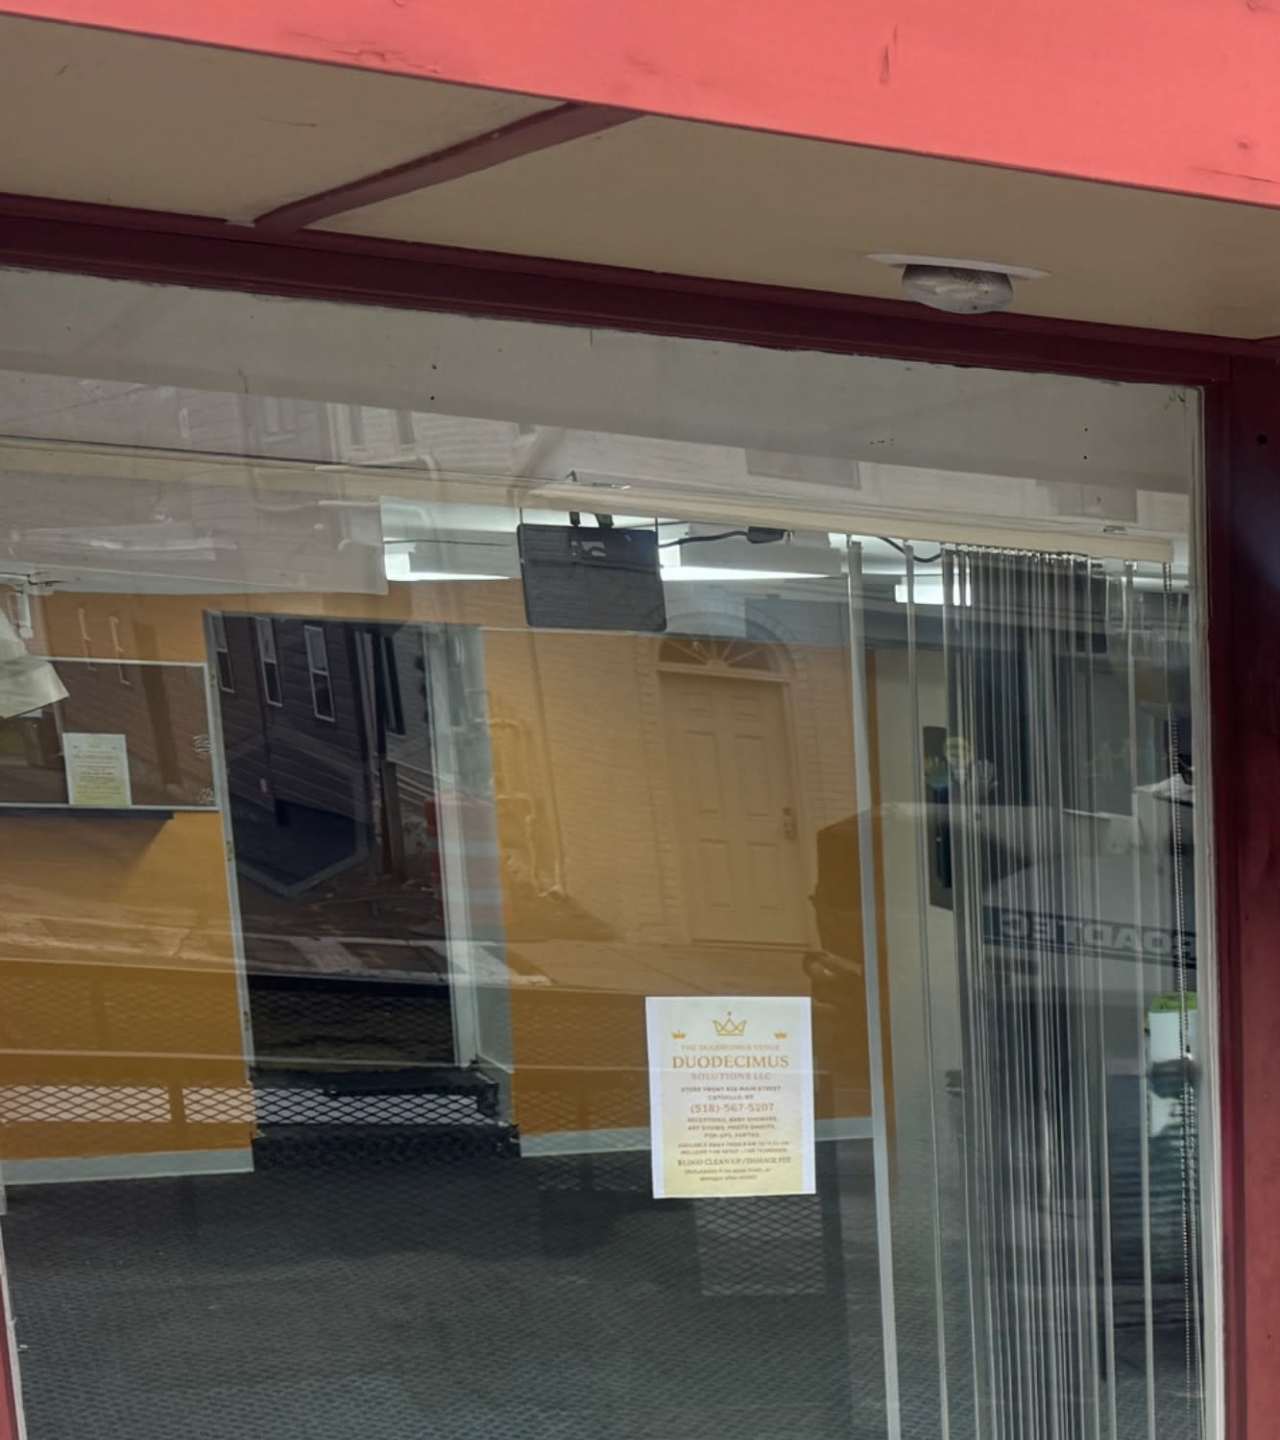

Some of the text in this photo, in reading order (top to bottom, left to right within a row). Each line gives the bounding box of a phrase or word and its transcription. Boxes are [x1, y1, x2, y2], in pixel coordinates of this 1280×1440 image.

[672, 1055, 789, 1069] DUODECIMUS
[691, 1072, 771, 1080] SOLUTIONS LLC
